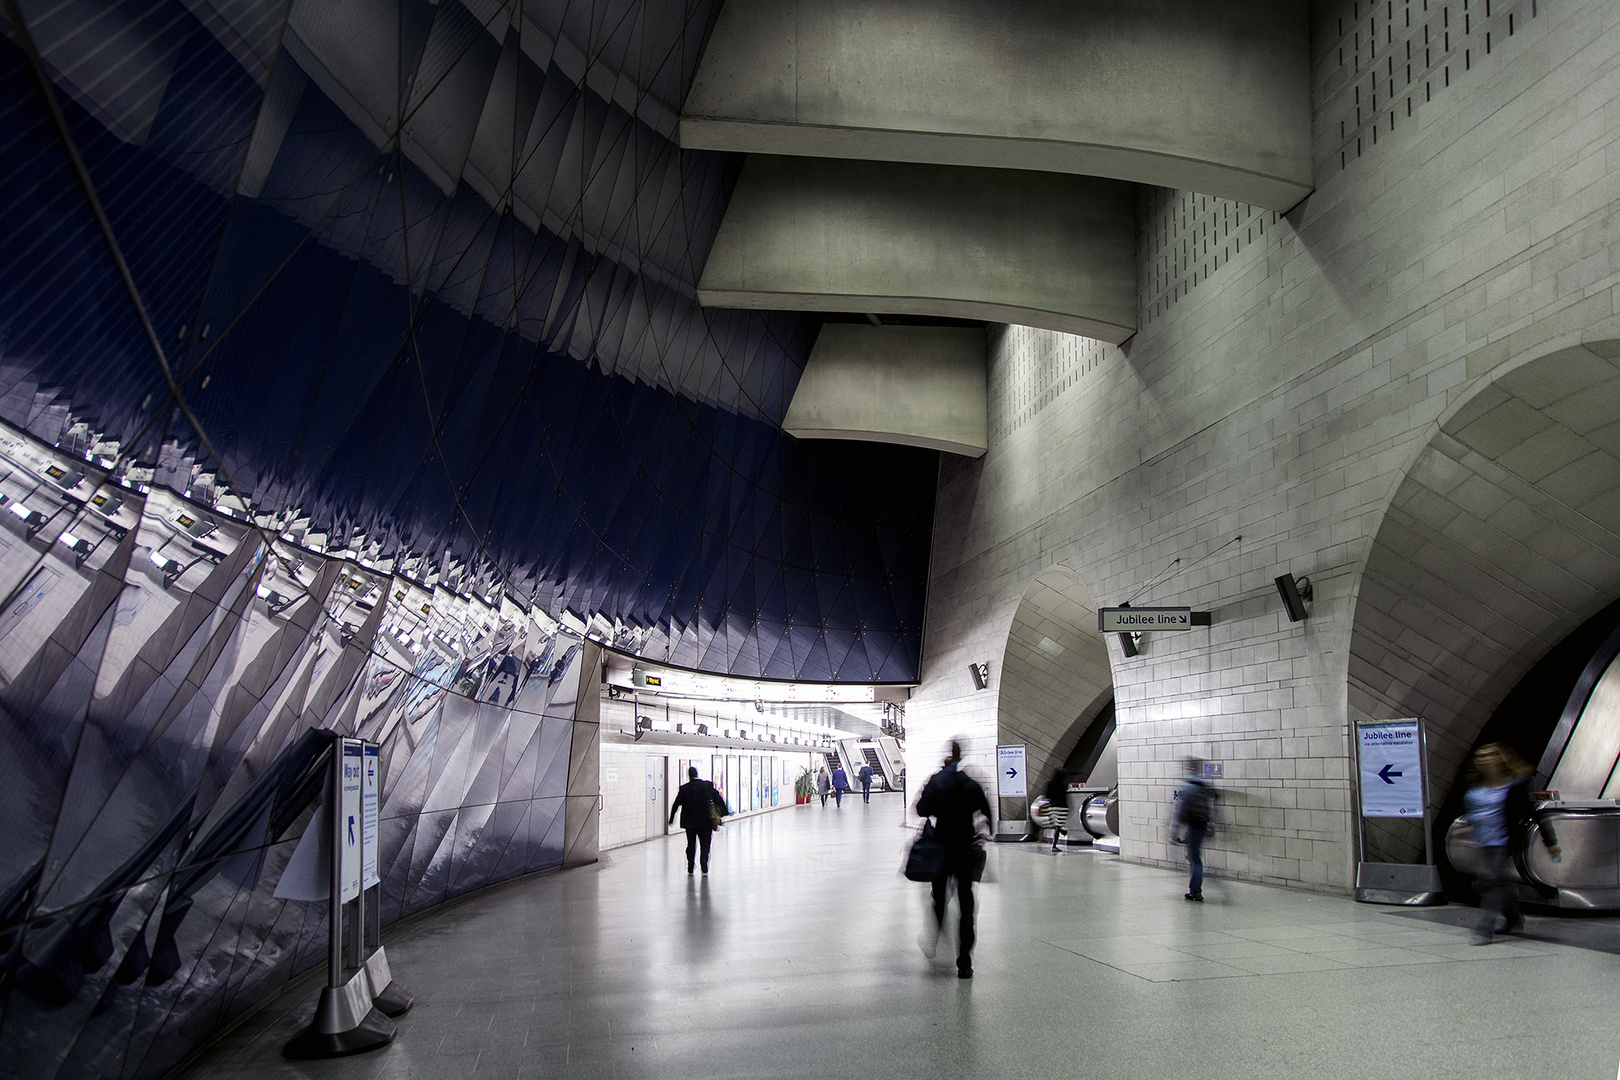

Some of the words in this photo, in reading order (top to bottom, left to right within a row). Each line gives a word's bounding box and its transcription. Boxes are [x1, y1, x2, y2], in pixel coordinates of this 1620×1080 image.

[1116, 615, 1154, 624] Jubilee
[1157, 614, 1177, 623] line
[1364, 731, 1393, 739] Jubilee
[1395, 731, 1412, 739] line
[344, 763, 353, 781] Way
